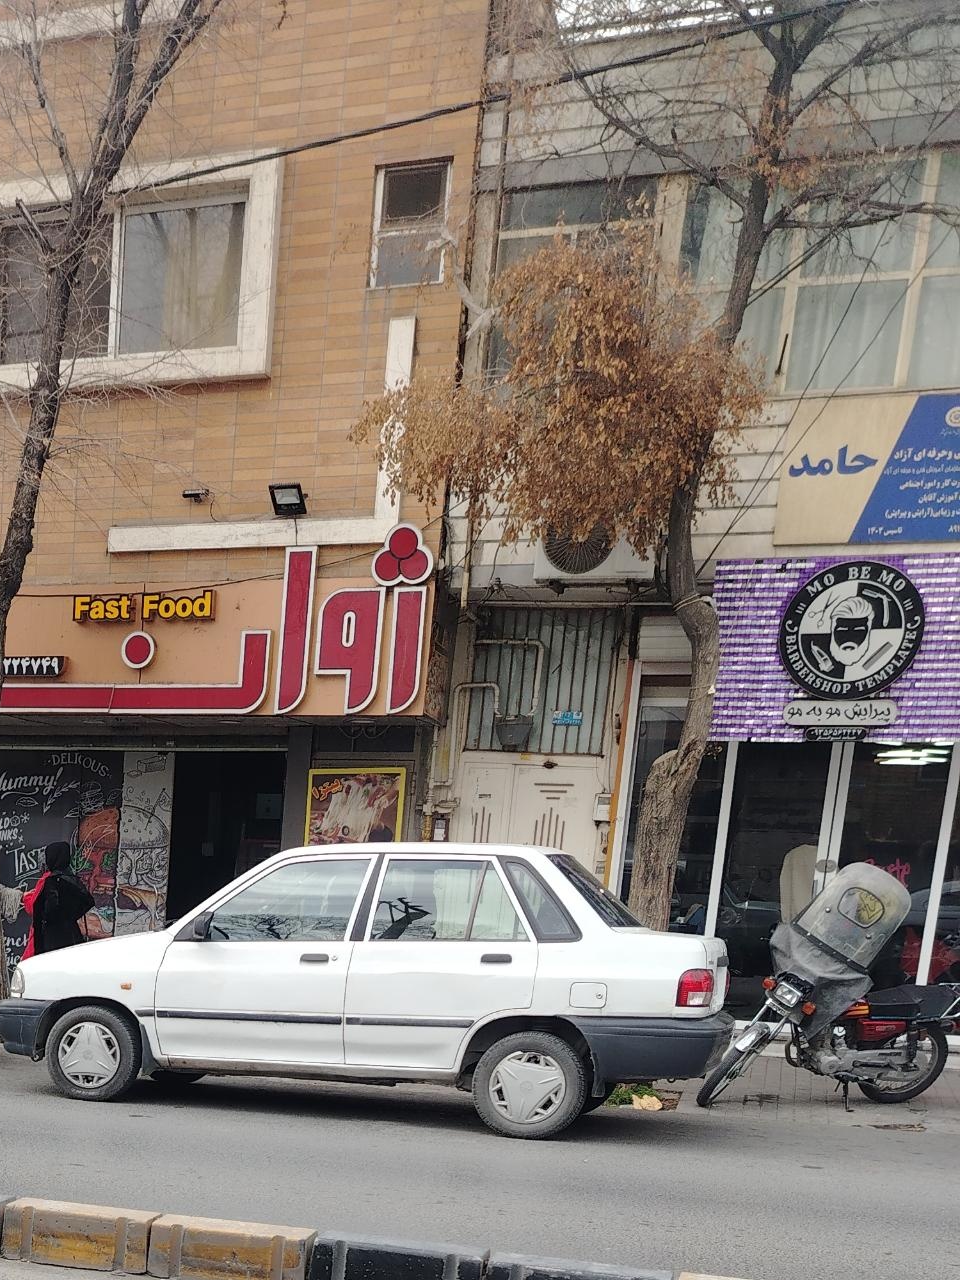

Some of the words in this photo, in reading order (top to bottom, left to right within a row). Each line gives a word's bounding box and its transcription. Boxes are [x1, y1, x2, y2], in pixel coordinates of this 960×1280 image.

[788, 444, 879, 478] حامد
[805, 573, 835, 597] MO
[847, 566, 872, 581] BE
[877, 569, 906, 592] MO
[73, 595, 133, 622] Fast
[142, 590, 215, 621] Food
[785, 633, 852, 694] BARBERSHOP
[854, 630, 917, 692] TEMPLATE
[787, 706, 803, 720] مو
[806, 705, 822, 721] به
[825, 706, 840, 720] مو
[844, 703, 891, 722] پیرایش
